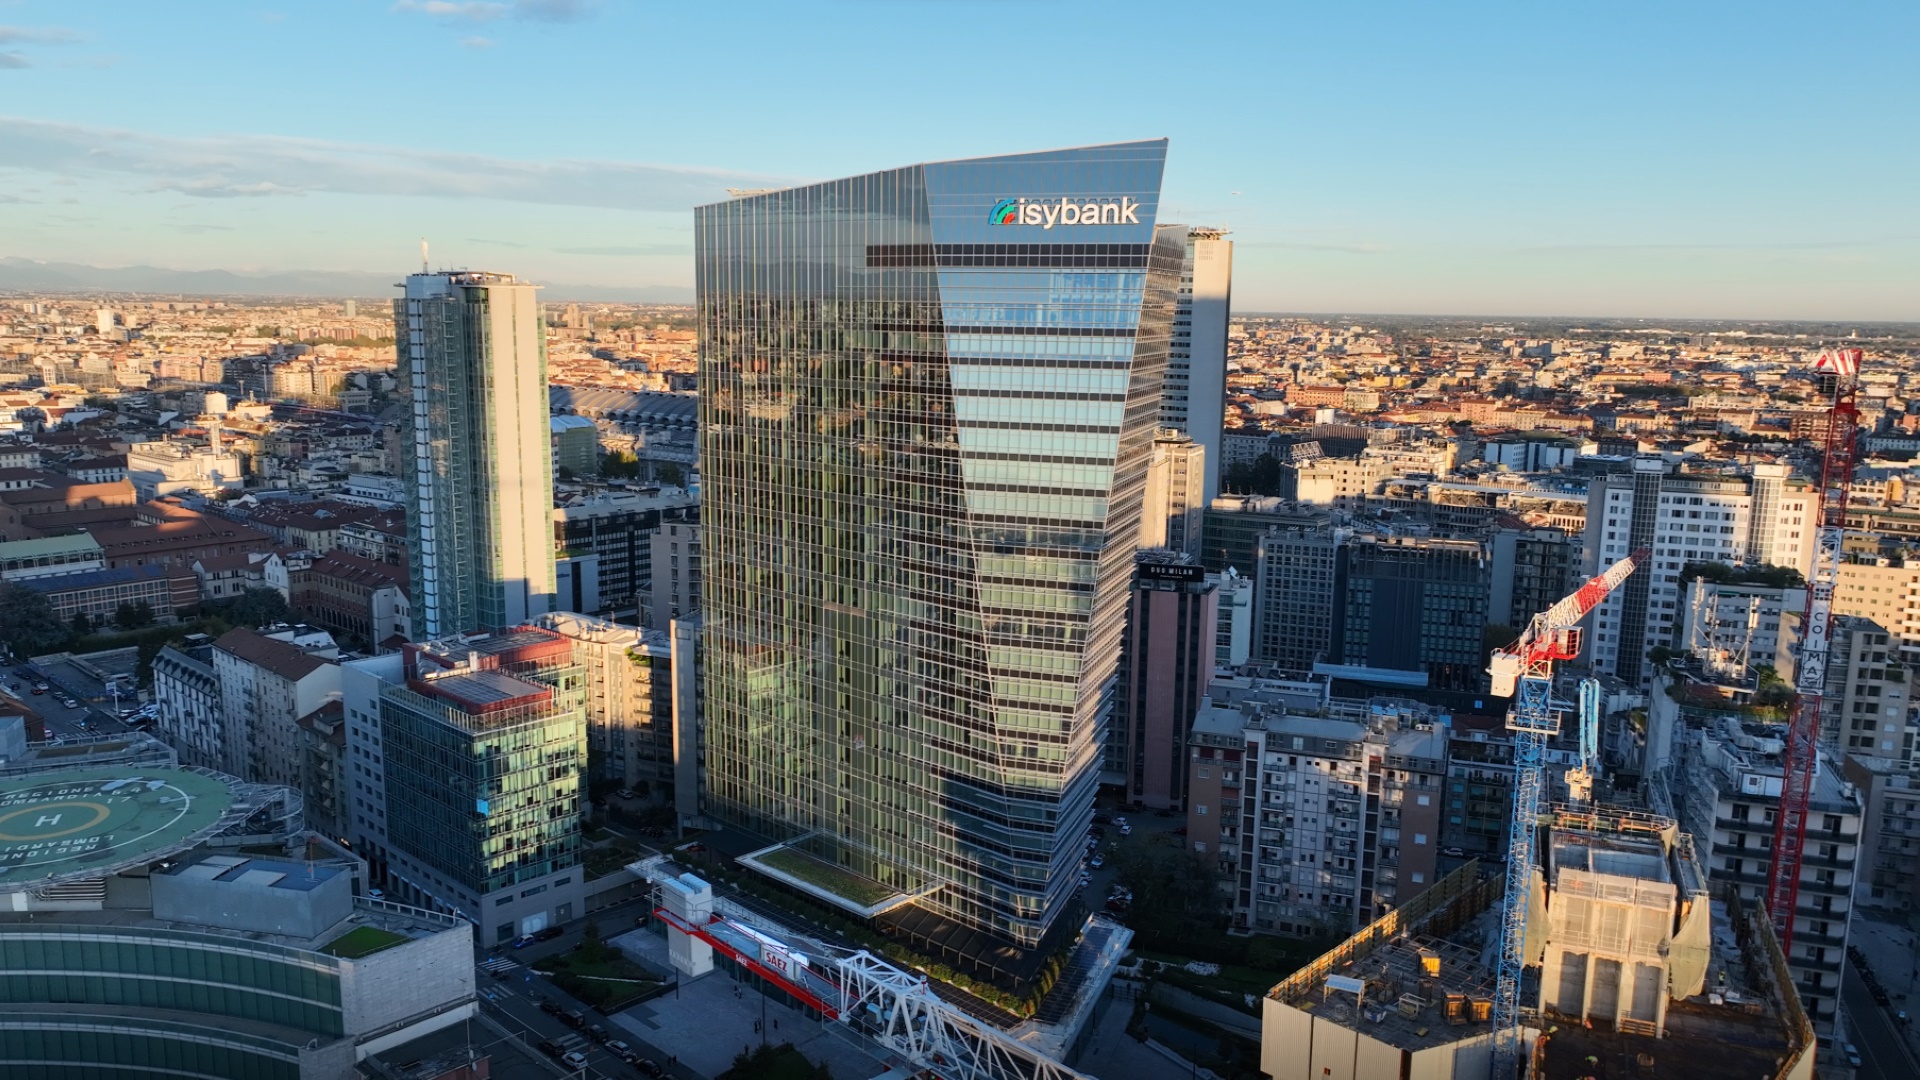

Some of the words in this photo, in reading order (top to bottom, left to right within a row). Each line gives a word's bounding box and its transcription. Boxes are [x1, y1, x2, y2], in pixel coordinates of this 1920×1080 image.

[1019, 196, 1140, 229] isybank
[1168, 567, 1193, 576] MILAN
[1806, 611, 1824, 676] COIMA
[1, 792, 102, 806] OMBARDIA
[107, 796, 132, 804] 17
[5, 786, 94, 799] REGIONE
[34, 813, 62, 827] H
[5, 834, 115, 852] LOMBARDI
[766, 952, 788, 972] SAEZ
